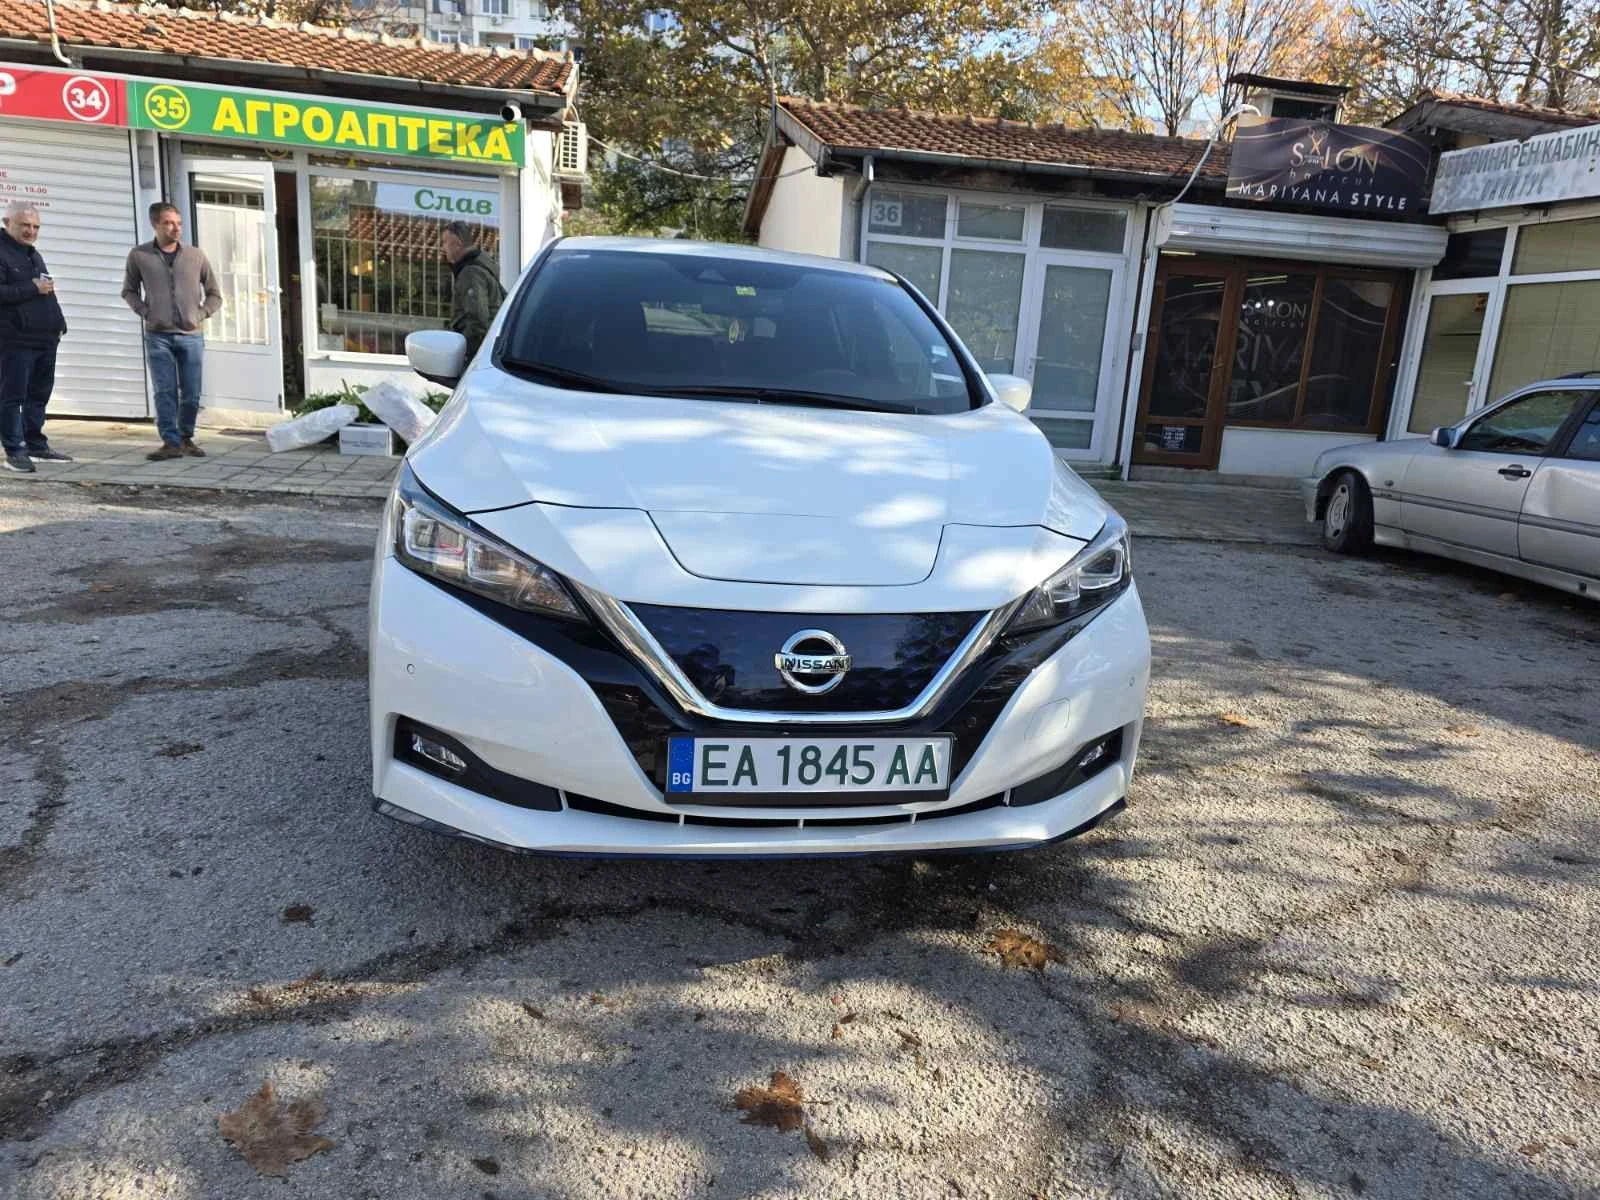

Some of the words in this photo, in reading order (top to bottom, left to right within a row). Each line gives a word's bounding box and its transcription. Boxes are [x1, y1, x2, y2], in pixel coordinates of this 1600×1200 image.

[70, 87, 102, 110] 34
[151, 95, 185, 120] 35
[212, 97, 512, 160] АГРОАПТЕКА
[414, 189, 493, 215] Слав
[1238, 181, 1340, 204] MARIYANA
[1351, 192, 1408, 211] STYLE
[874, 204, 898, 223] 36
[783, 658, 846, 671] NISSAN
[701, 744, 758, 786] EA
[776, 744, 876, 786] 1845
[886, 744, 939, 785] AA
[672, 773, 691, 785] BG
